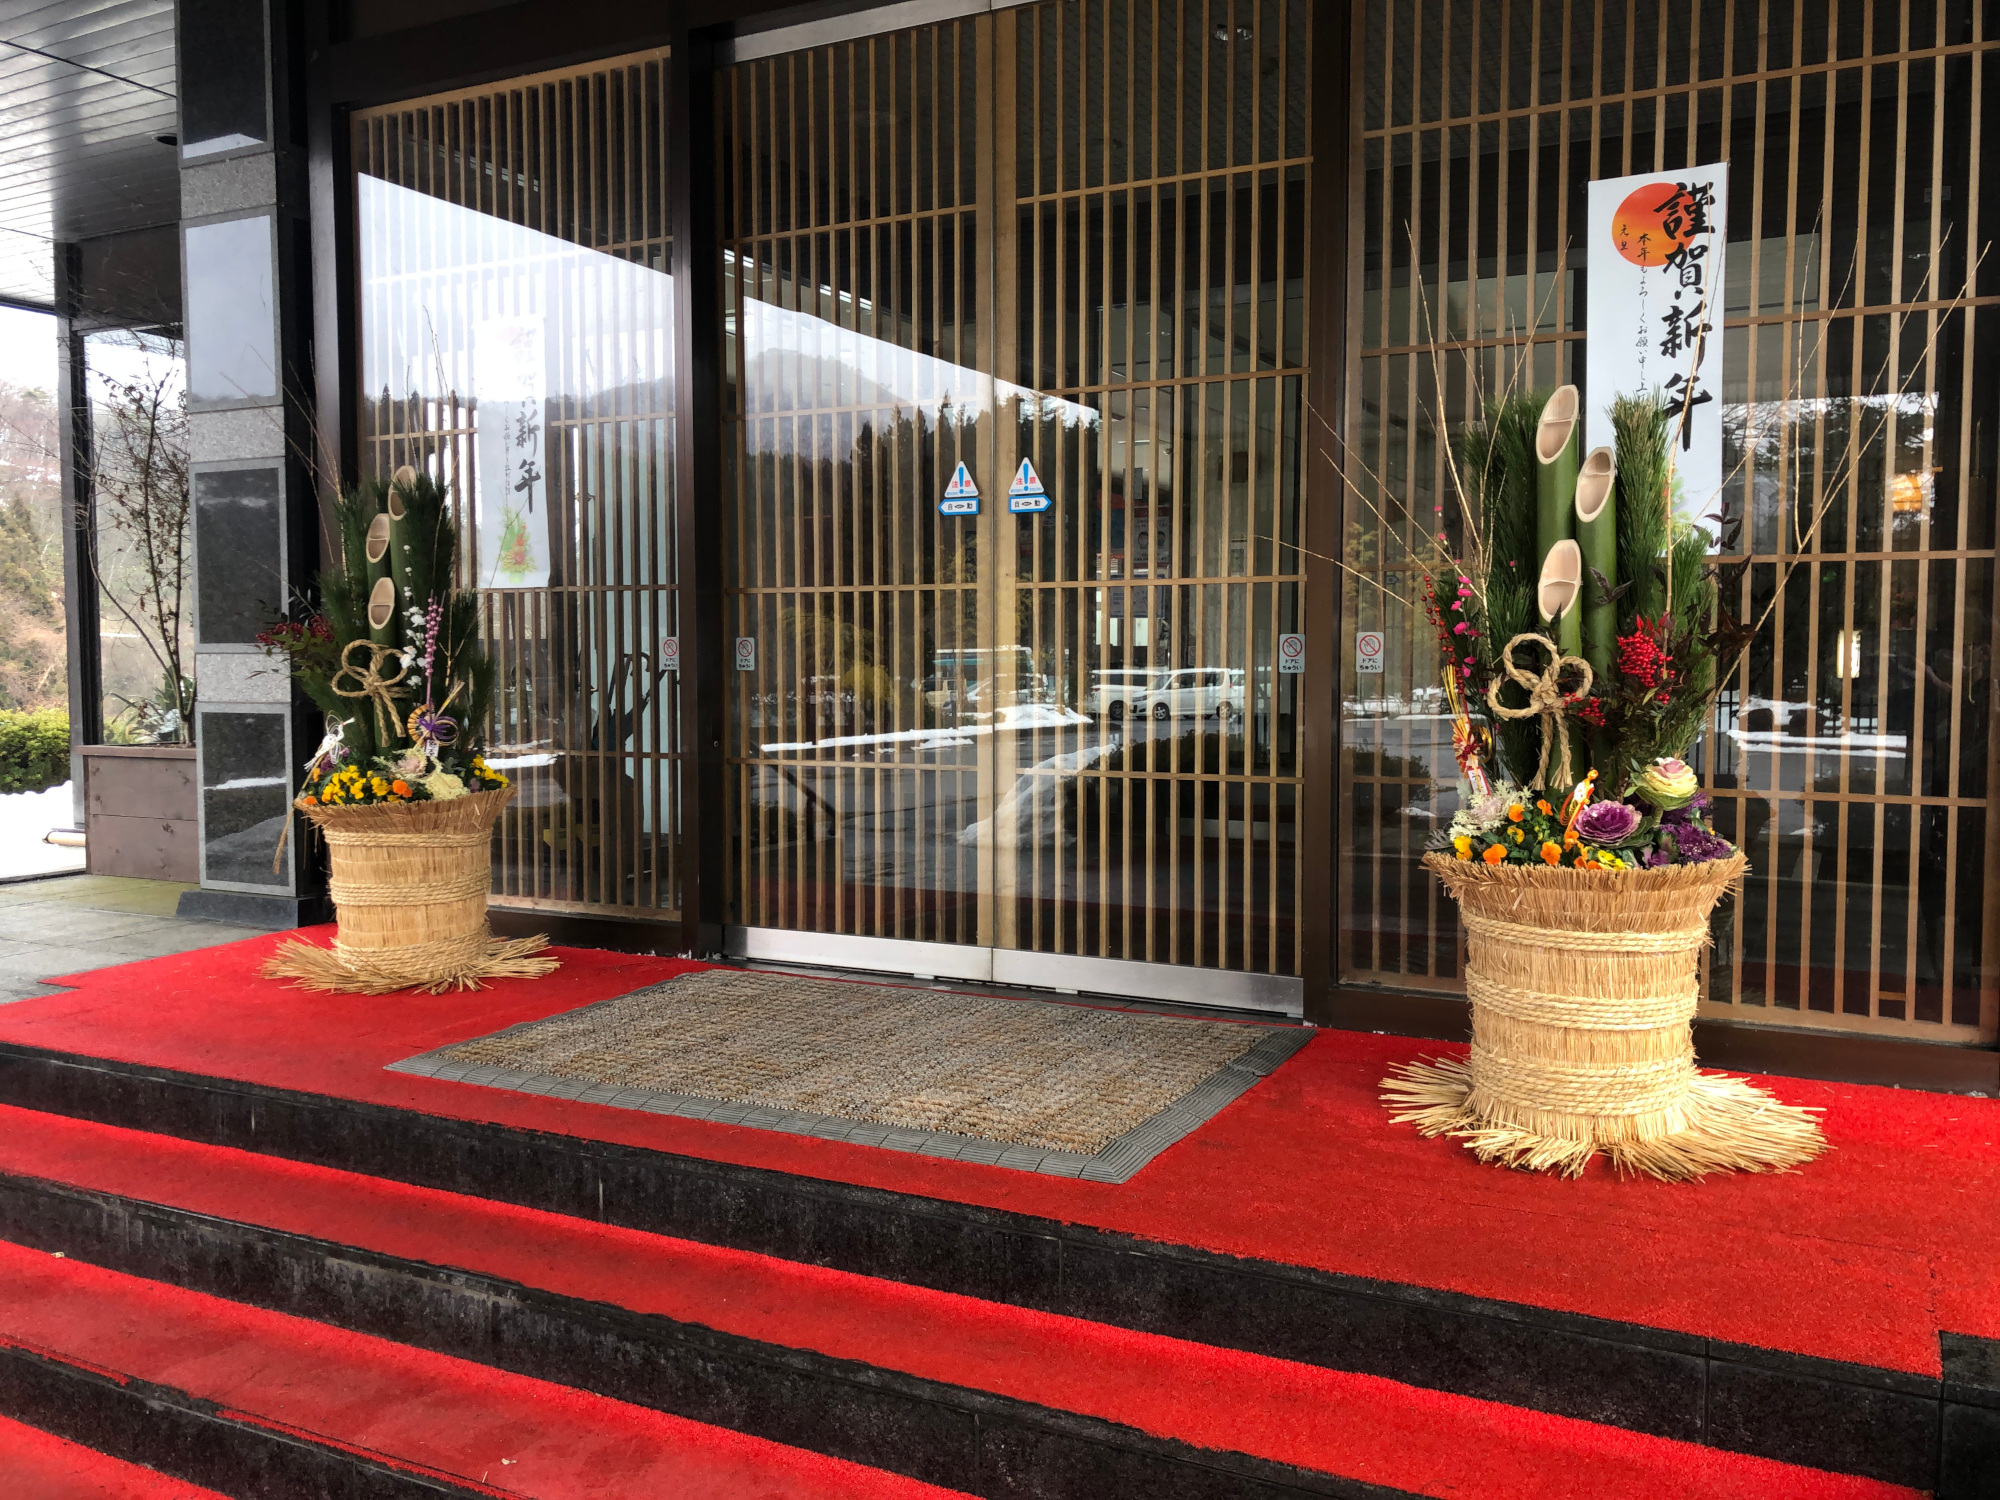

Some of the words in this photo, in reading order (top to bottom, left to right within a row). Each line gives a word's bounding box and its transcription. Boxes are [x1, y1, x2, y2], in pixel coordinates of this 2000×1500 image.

[1619, 223, 1630, 251] 元旦
[1653, 182, 1716, 453] 謹賀新年
